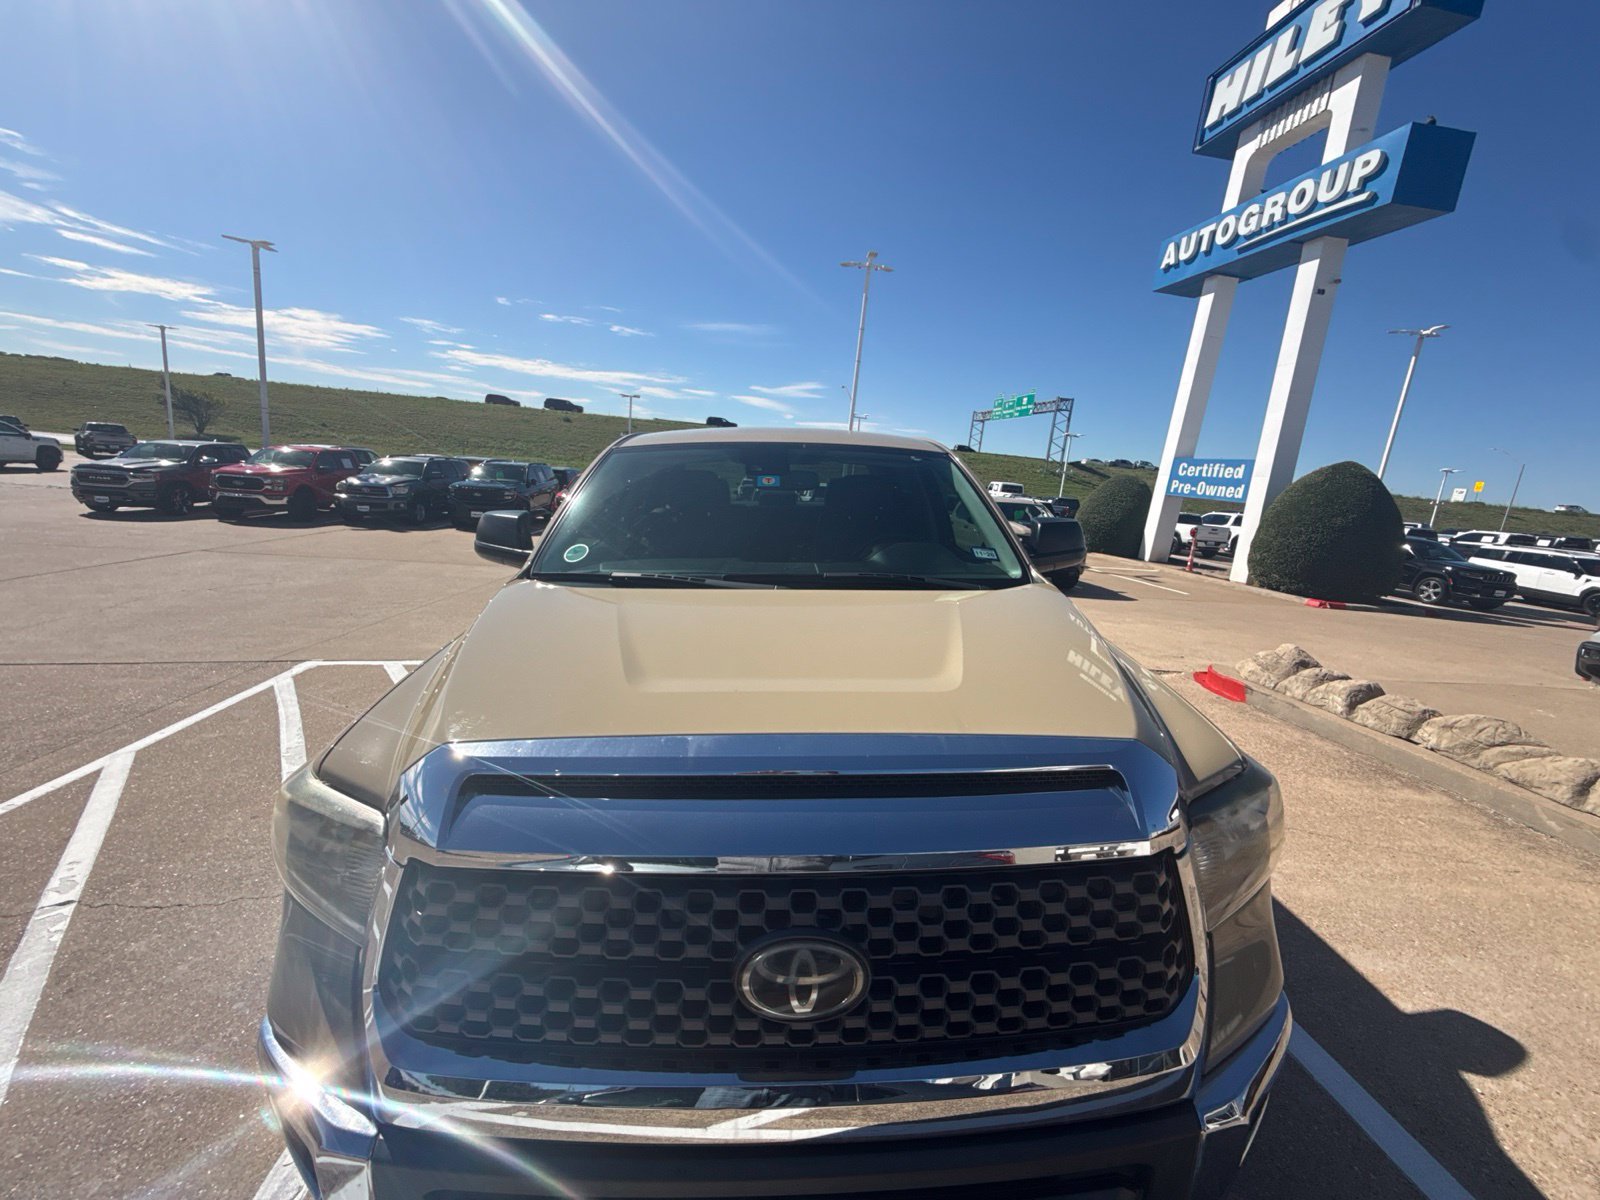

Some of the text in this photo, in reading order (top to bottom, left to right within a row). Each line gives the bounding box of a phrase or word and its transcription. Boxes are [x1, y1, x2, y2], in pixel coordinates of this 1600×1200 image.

[1160, 148, 1386, 270] AUTOGROUP
[1178, 462, 1245, 479] Certified
[1170, 480, 1245, 498] Pre-Owned
